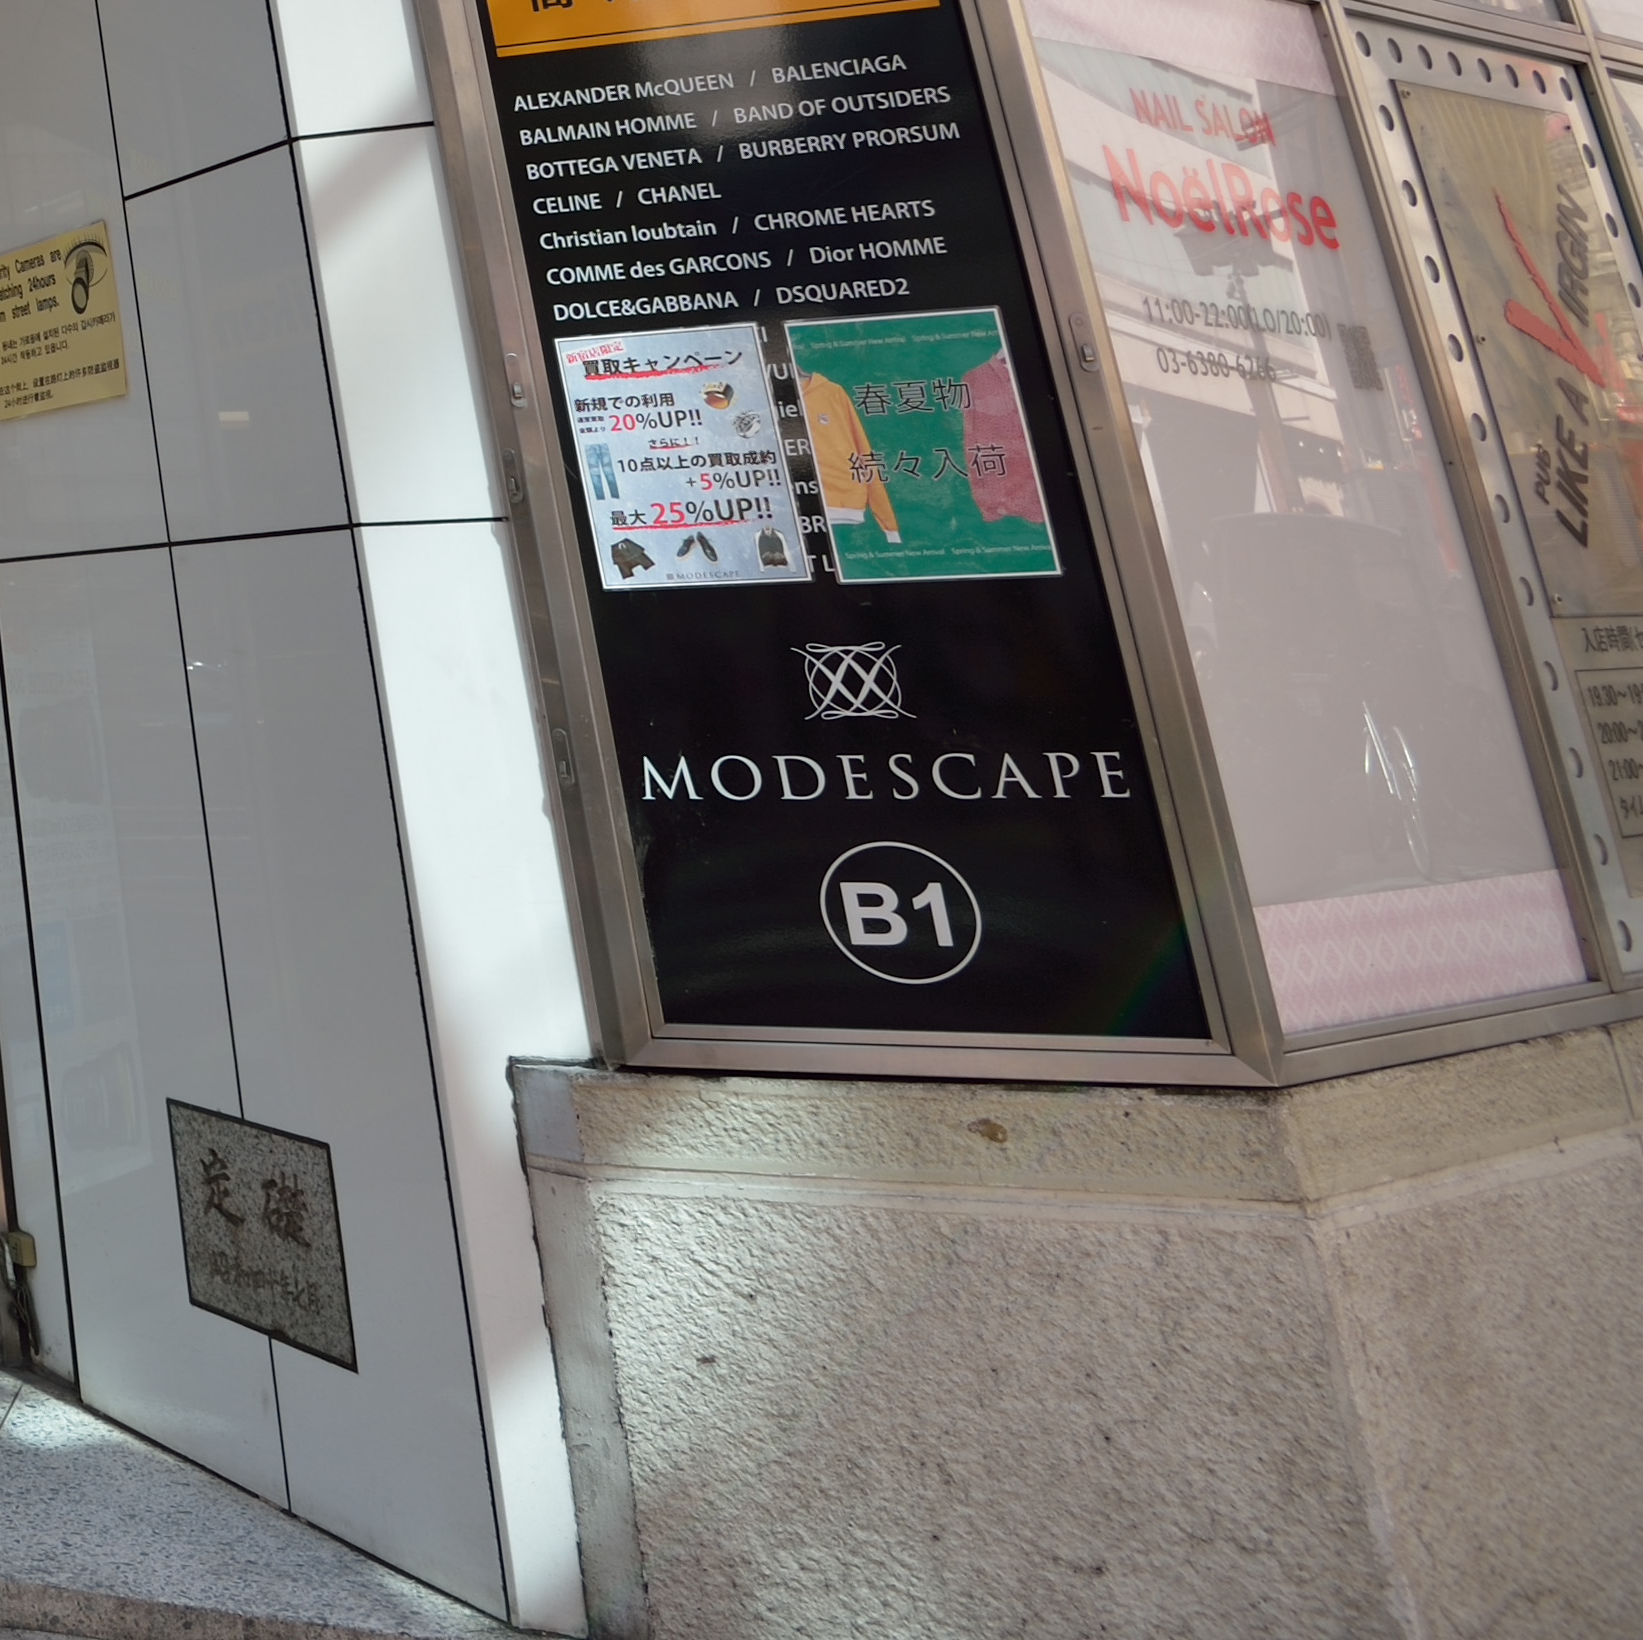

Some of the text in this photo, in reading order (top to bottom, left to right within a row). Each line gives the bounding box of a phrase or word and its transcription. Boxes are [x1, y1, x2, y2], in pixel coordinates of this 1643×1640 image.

[514, 55, 906, 113] ALEXANDER McQUEEN BALENCIAGA
[519, 85, 951, 147] BALMAIN HOMME BAND OF OUTSIDERS
[1130, 87, 1276, 146] NAIL SALON
[525, 122, 960, 181] BOTTEGA VENETA BURBERRY PRORSUM
[532, 182, 722, 215] CELINE CHANEL
[539, 198, 935, 250] Christian loubtain CHROME HEARTS
[15, 255, 45, 273] Cameras
[546, 236, 947, 286] COMME des GARCONS Dior HOMME
[28, 274, 56, 292] 24hours
[552, 276, 910, 322] DOLCE&GABBANA DSQUARED2
[12, 302, 31, 319] street
[583, 351, 743, 375] 買取キャンペーン
[574, 392, 675, 413] 新規での利用
[855, 377, 972, 416] 春夏物
[609, 409, 703, 432] 20%UP!!
[617, 451, 777, 473] 10点以上の買取成約
[848, 446, 1006, 484] 続々入荷
[1533, 440, 1553, 505] PUB
[1555, 376, 1589, 548] LIKE A
[610, 497, 773, 526] 最大 25%UP!!
[642, 750, 1132, 801] MODESCAPE
[839, 881, 955, 947] B1
